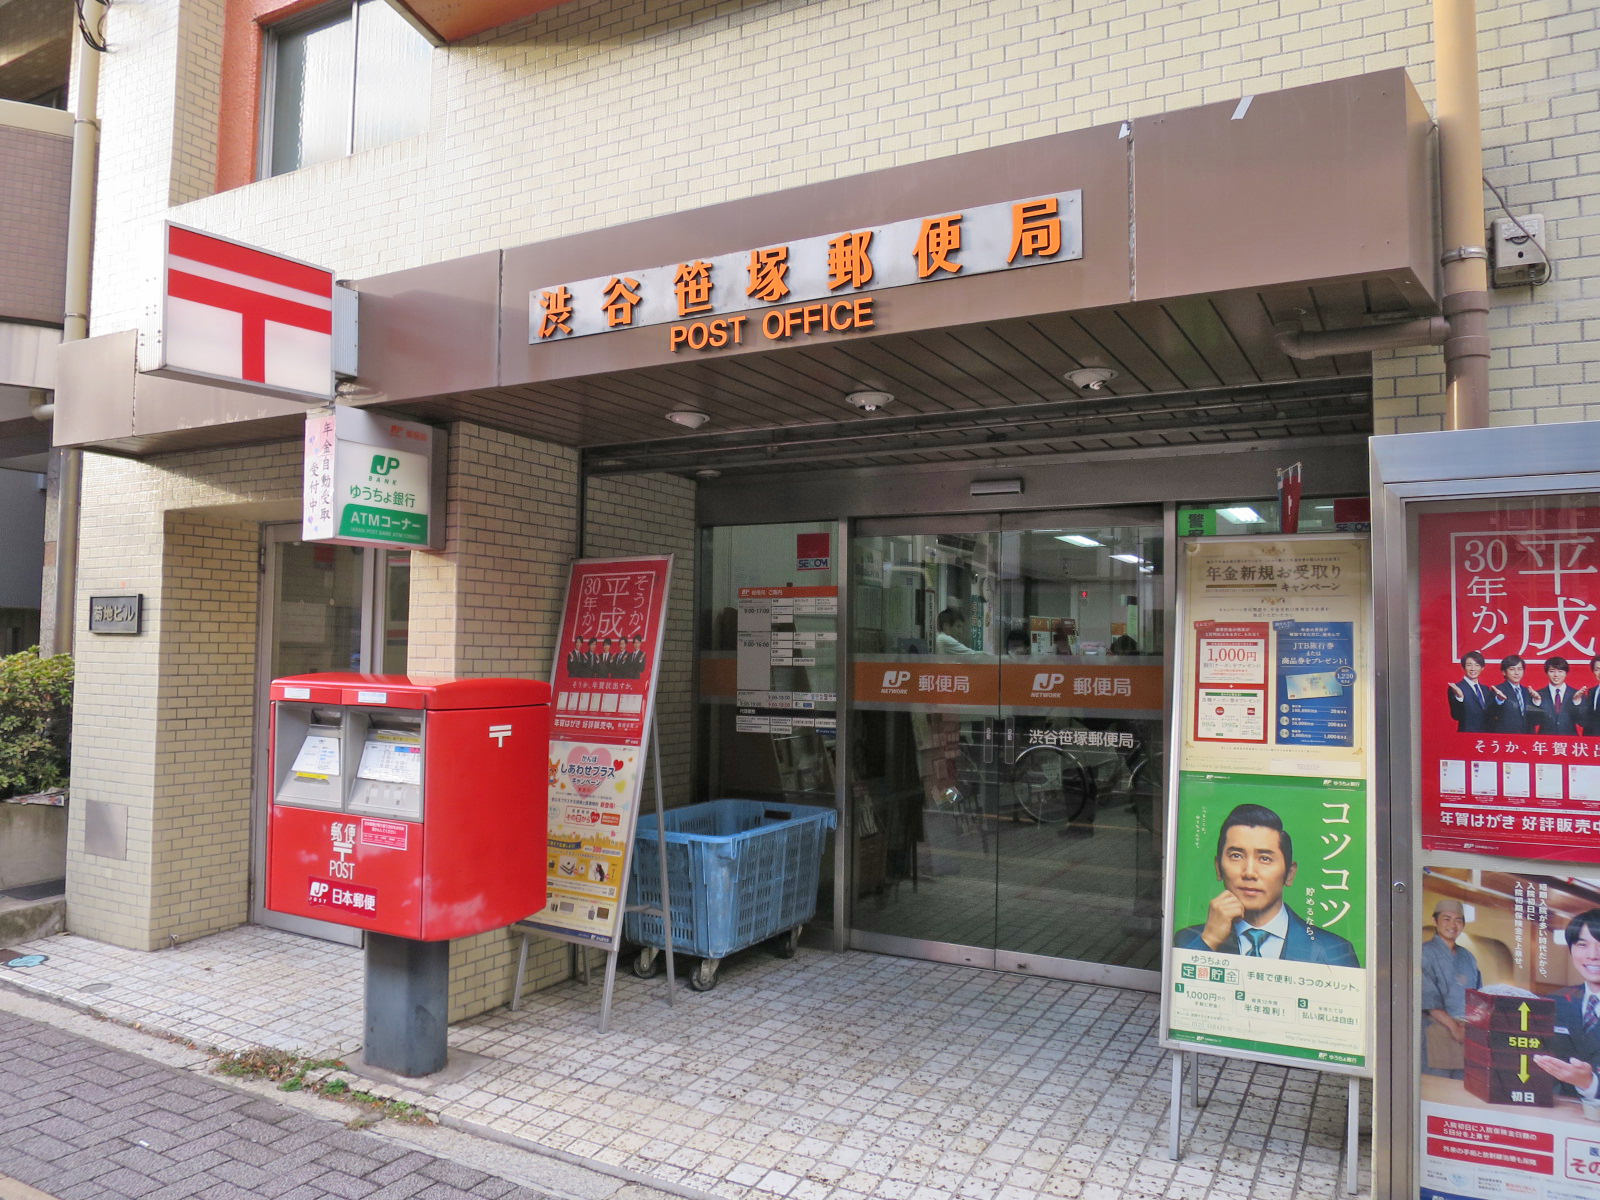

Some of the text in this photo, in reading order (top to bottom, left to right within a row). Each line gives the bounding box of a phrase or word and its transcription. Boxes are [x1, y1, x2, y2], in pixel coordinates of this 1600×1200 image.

[537, 197, 1063, 339] 渋谷笹塚郵便局
[669, 297, 875, 352] POST OFFICE
[319, 421, 333, 522] 年金自動受取
[370, 454, 400, 476] JP
[309, 462, 320, 513] 受付中
[368, 476, 397, 486] BANK
[350, 485, 416, 508] ゆうちょ銀行
[350, 511, 421, 530] ATMコーナー
[1206, 564, 1341, 581] 年金新規お受取り
[1281, 582, 1341, 592] キャンペーン
[1517, 535, 1598, 657] 平成
[596, 575, 631, 638] 平成
[1207, 648, 1257, 662] 1,000円
[1293, 642, 1335, 650] JTB旅行券
[1281, 657, 1348, 665] 商品券をプレゼント!
[882, 670, 911, 688] JP
[918, 675, 970, 694] 郵便局
[1032, 673, 1065, 691] JP
[1073, 677, 1132, 697] 郵便局
[554, 718, 582, 728] 年賀はがき
[1028, 729, 1135, 749] 渋谷笹塚郵便局
[560, 763, 616, 778] しあわせプラス
[571, 777, 602, 786] キャンペーン
[1440, 811, 1515, 829] 年賀はがき
[330, 821, 356, 845] 郵便
[329, 860, 356, 881] POST
[1320, 802, 1351, 928] コツコツ
[310, 881, 376, 912] JP 日本郵便
[1527, 882, 1535, 921] 入院初日に
[1305, 887, 1315, 940] 貯めるなら。
[1191, 955, 1230, 966] ゆうちょの
[1182, 964, 1238, 983] 定額貯金
[1247, 971, 1360, 993] 手軽で便利、3つのメリット。
[1186, 990, 1226, 1002] 1,000円から
[1244, 1004, 1286, 1017] 半年複利!
[1302, 1011, 1359, 1026] 払い戻しは自由!
[1509, 1037, 1541, 1049] 5日分
[1511, 1091, 1535, 1103] 初日
[1443, 1128, 1491, 1141] 5日分を上乗せ
